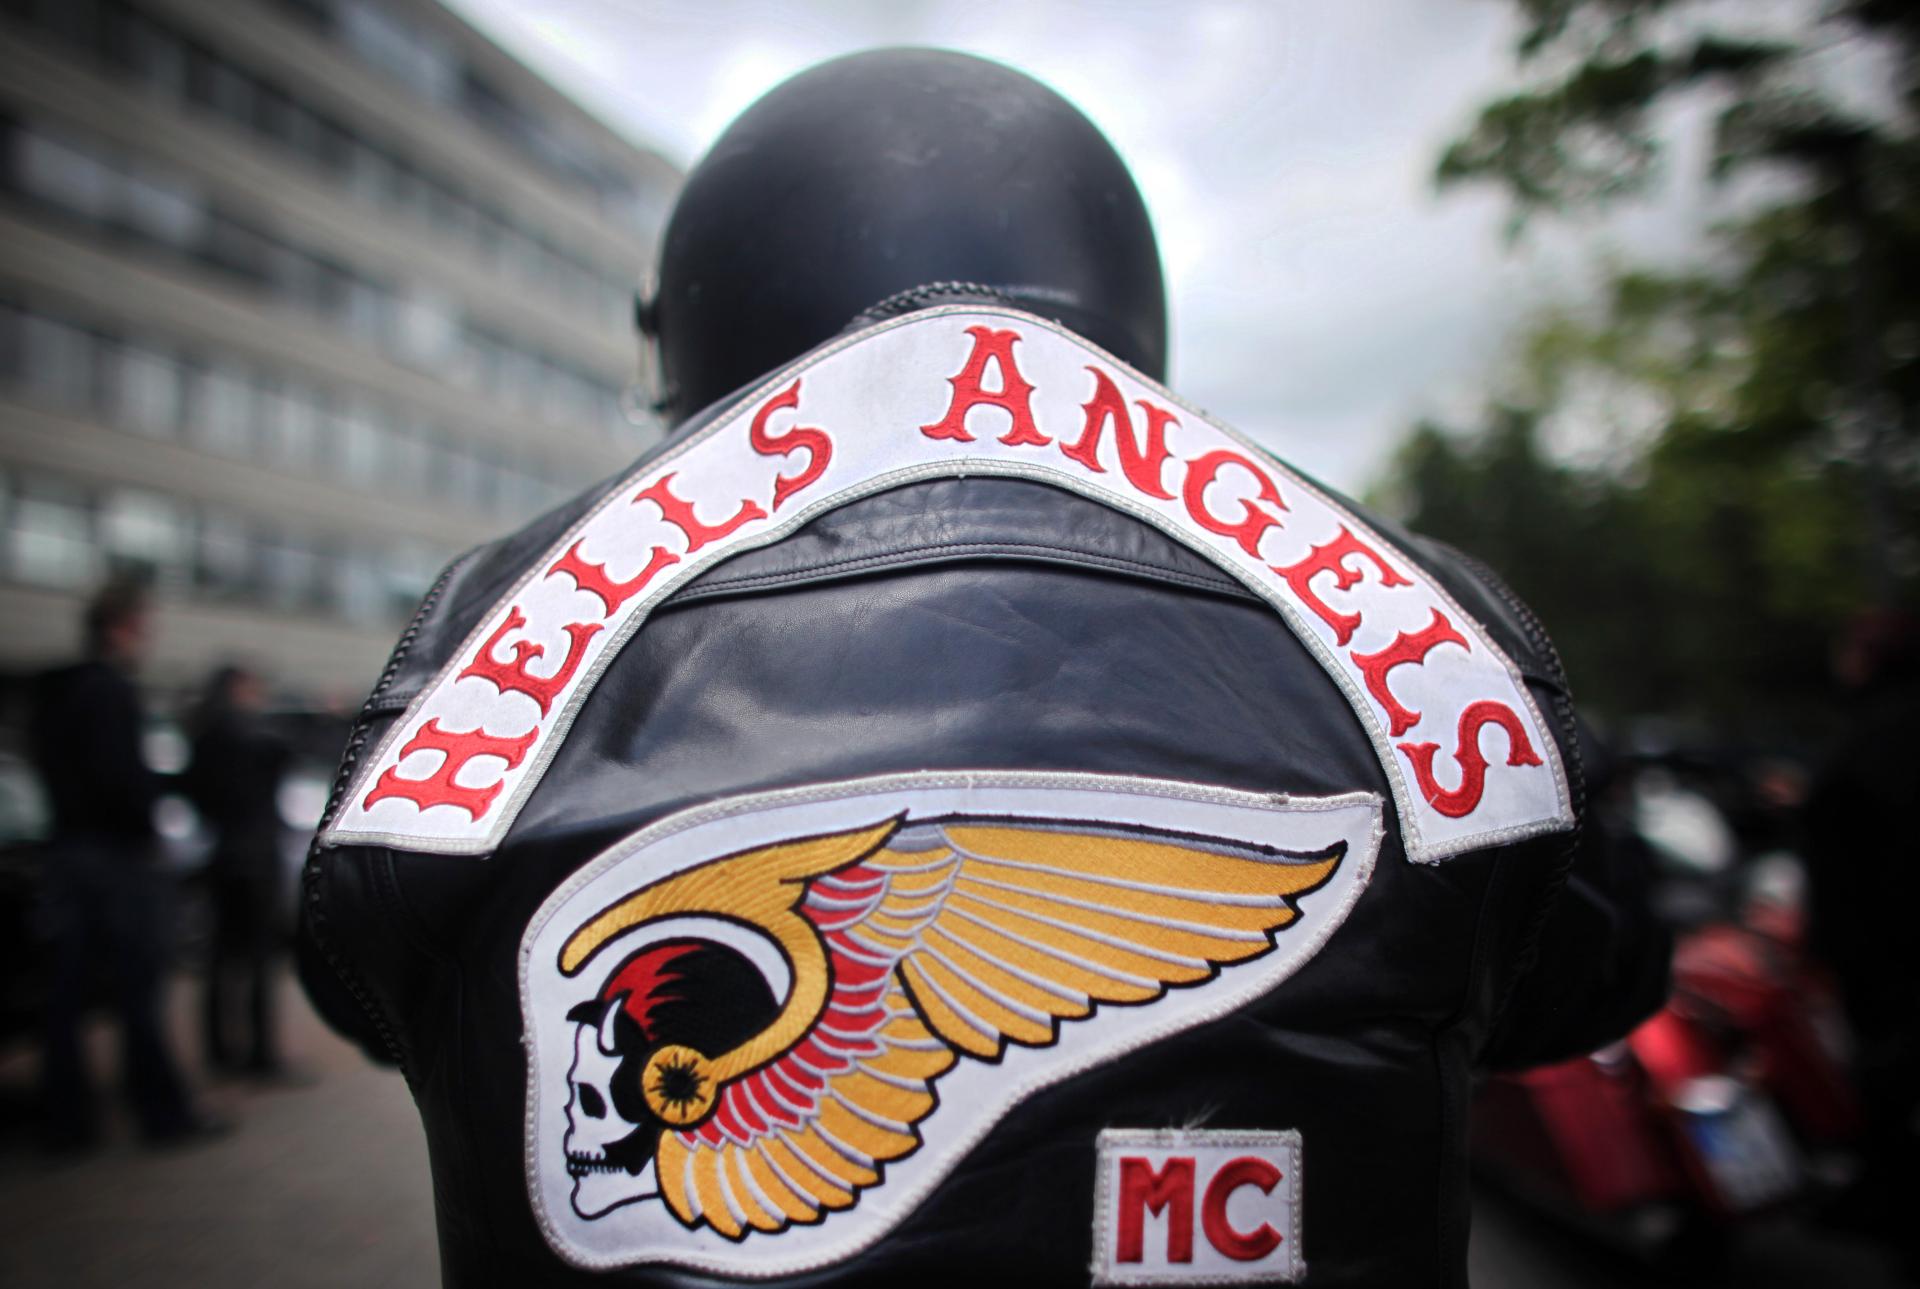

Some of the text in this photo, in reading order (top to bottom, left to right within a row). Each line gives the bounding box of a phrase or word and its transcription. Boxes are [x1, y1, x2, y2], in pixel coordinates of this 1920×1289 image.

[363, 325, 1543, 822] HELLS ANGELS
[1116, 1156, 1283, 1264] MC
